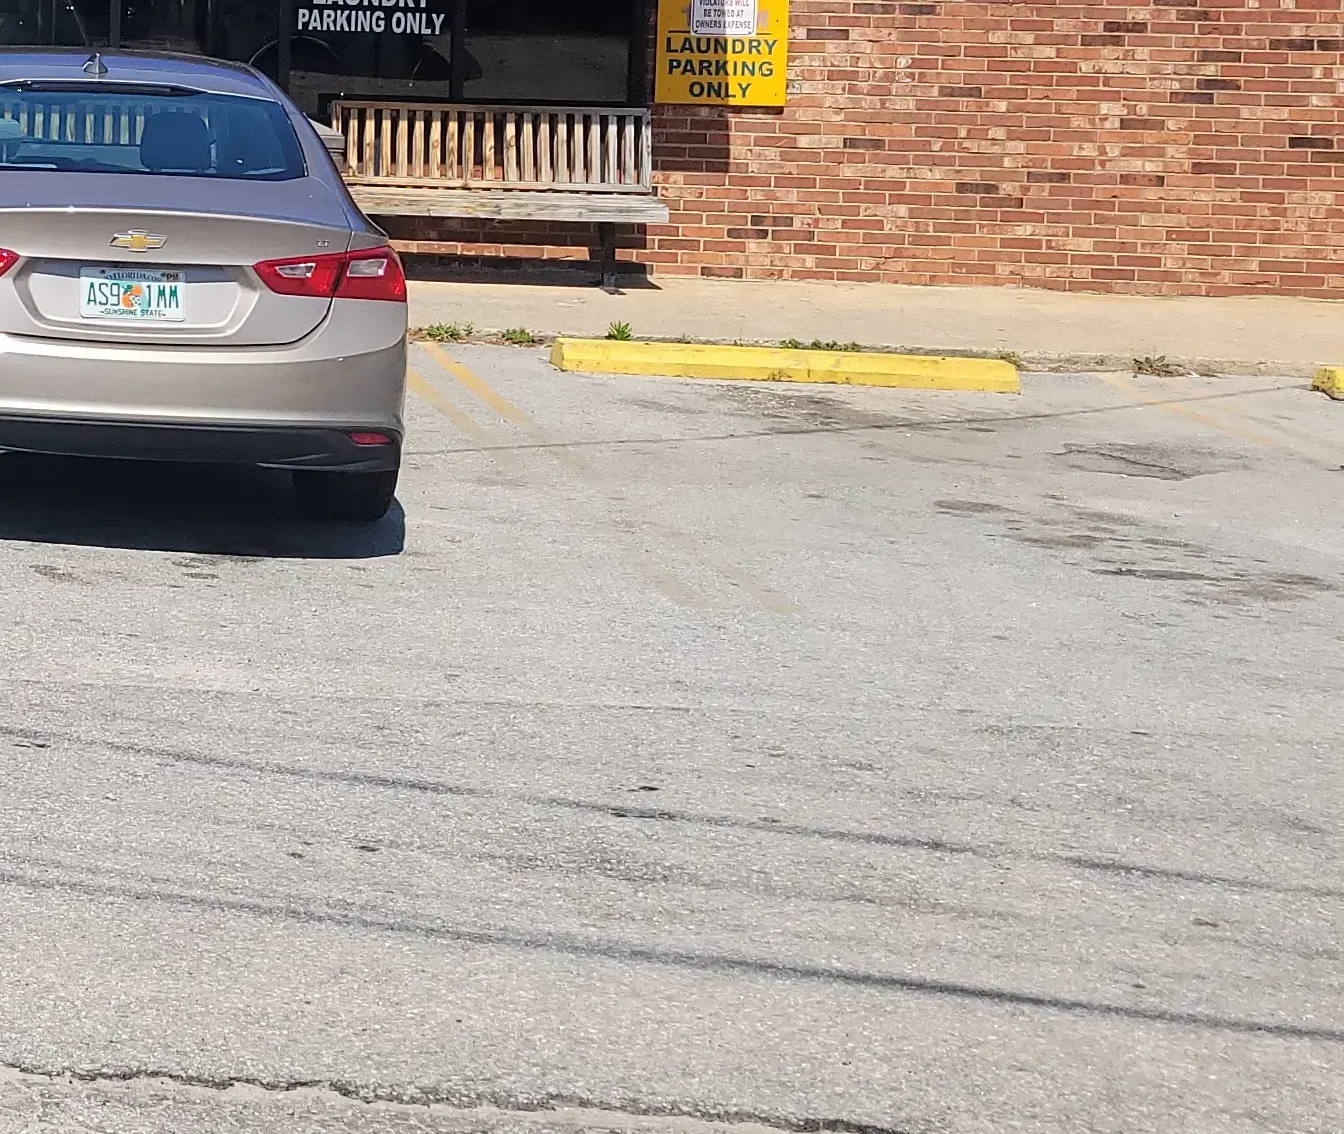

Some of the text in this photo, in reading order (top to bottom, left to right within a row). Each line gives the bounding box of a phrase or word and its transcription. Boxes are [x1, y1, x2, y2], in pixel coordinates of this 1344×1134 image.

[297, 8, 445, 35] PARKING ONLY
[703, 9, 712, 17] BE
[713, 9, 735, 17] TOWED
[695, 19, 751, 29] OWNERS EXPENSE
[666, 37, 778, 56] LAUNDRY
[668, 58, 774, 77] PARKING
[688, 81, 752, 99] ONLY
[104, 308, 163, 317] SUNSHINE STATE
